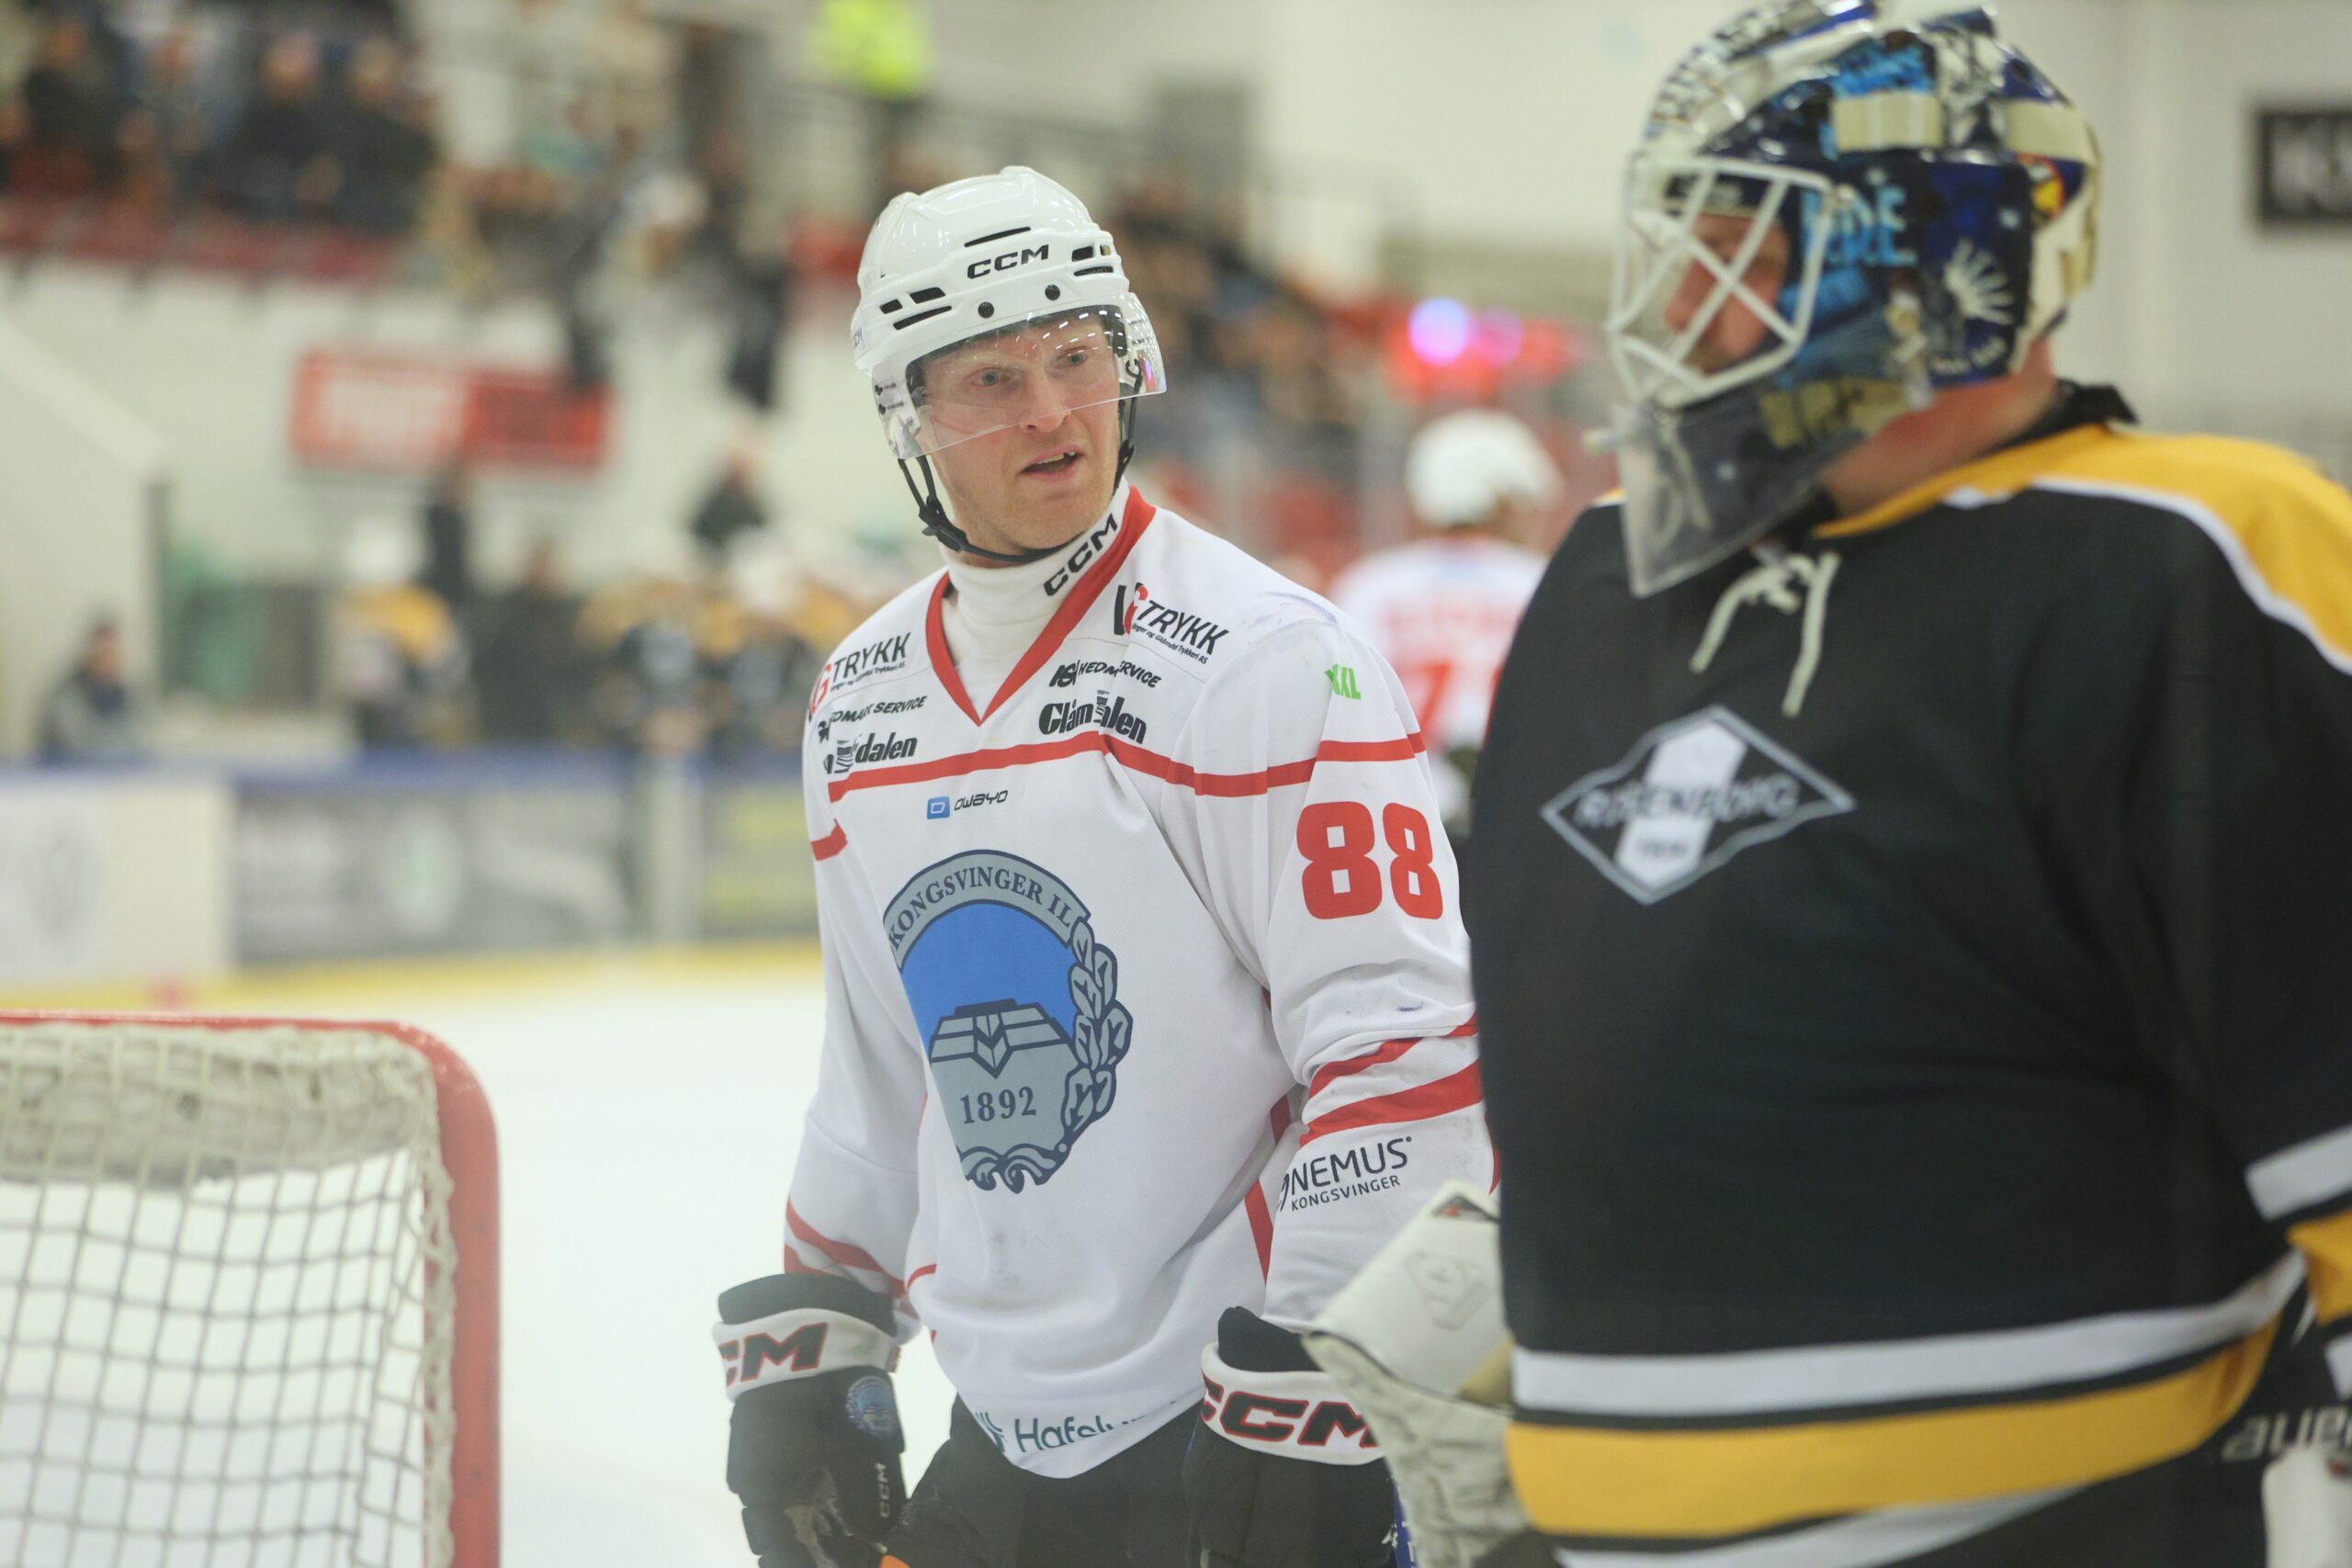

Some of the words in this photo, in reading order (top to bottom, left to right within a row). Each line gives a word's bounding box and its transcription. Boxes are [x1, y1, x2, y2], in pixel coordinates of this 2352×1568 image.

[967, 244, 1049, 279] CCM
[1044, 513, 1118, 596] CCM
[1137, 600, 1229, 656] TRYKK
[832, 632, 912, 682] TRYKK
[1079, 660, 1120, 678] HEDM
[1120, 660, 1162, 688] RVICE
[1324, 663, 1362, 700] XXL
[874, 695, 928, 714] SERVICE
[1296, 801, 1443, 919] 88
[888, 866, 1044, 952] KONGSVINGER
[1047, 895, 1074, 929] IL
[960, 1086, 1036, 1124] 1892
[1292, 1175, 1401, 1212] KONGSVINGER
